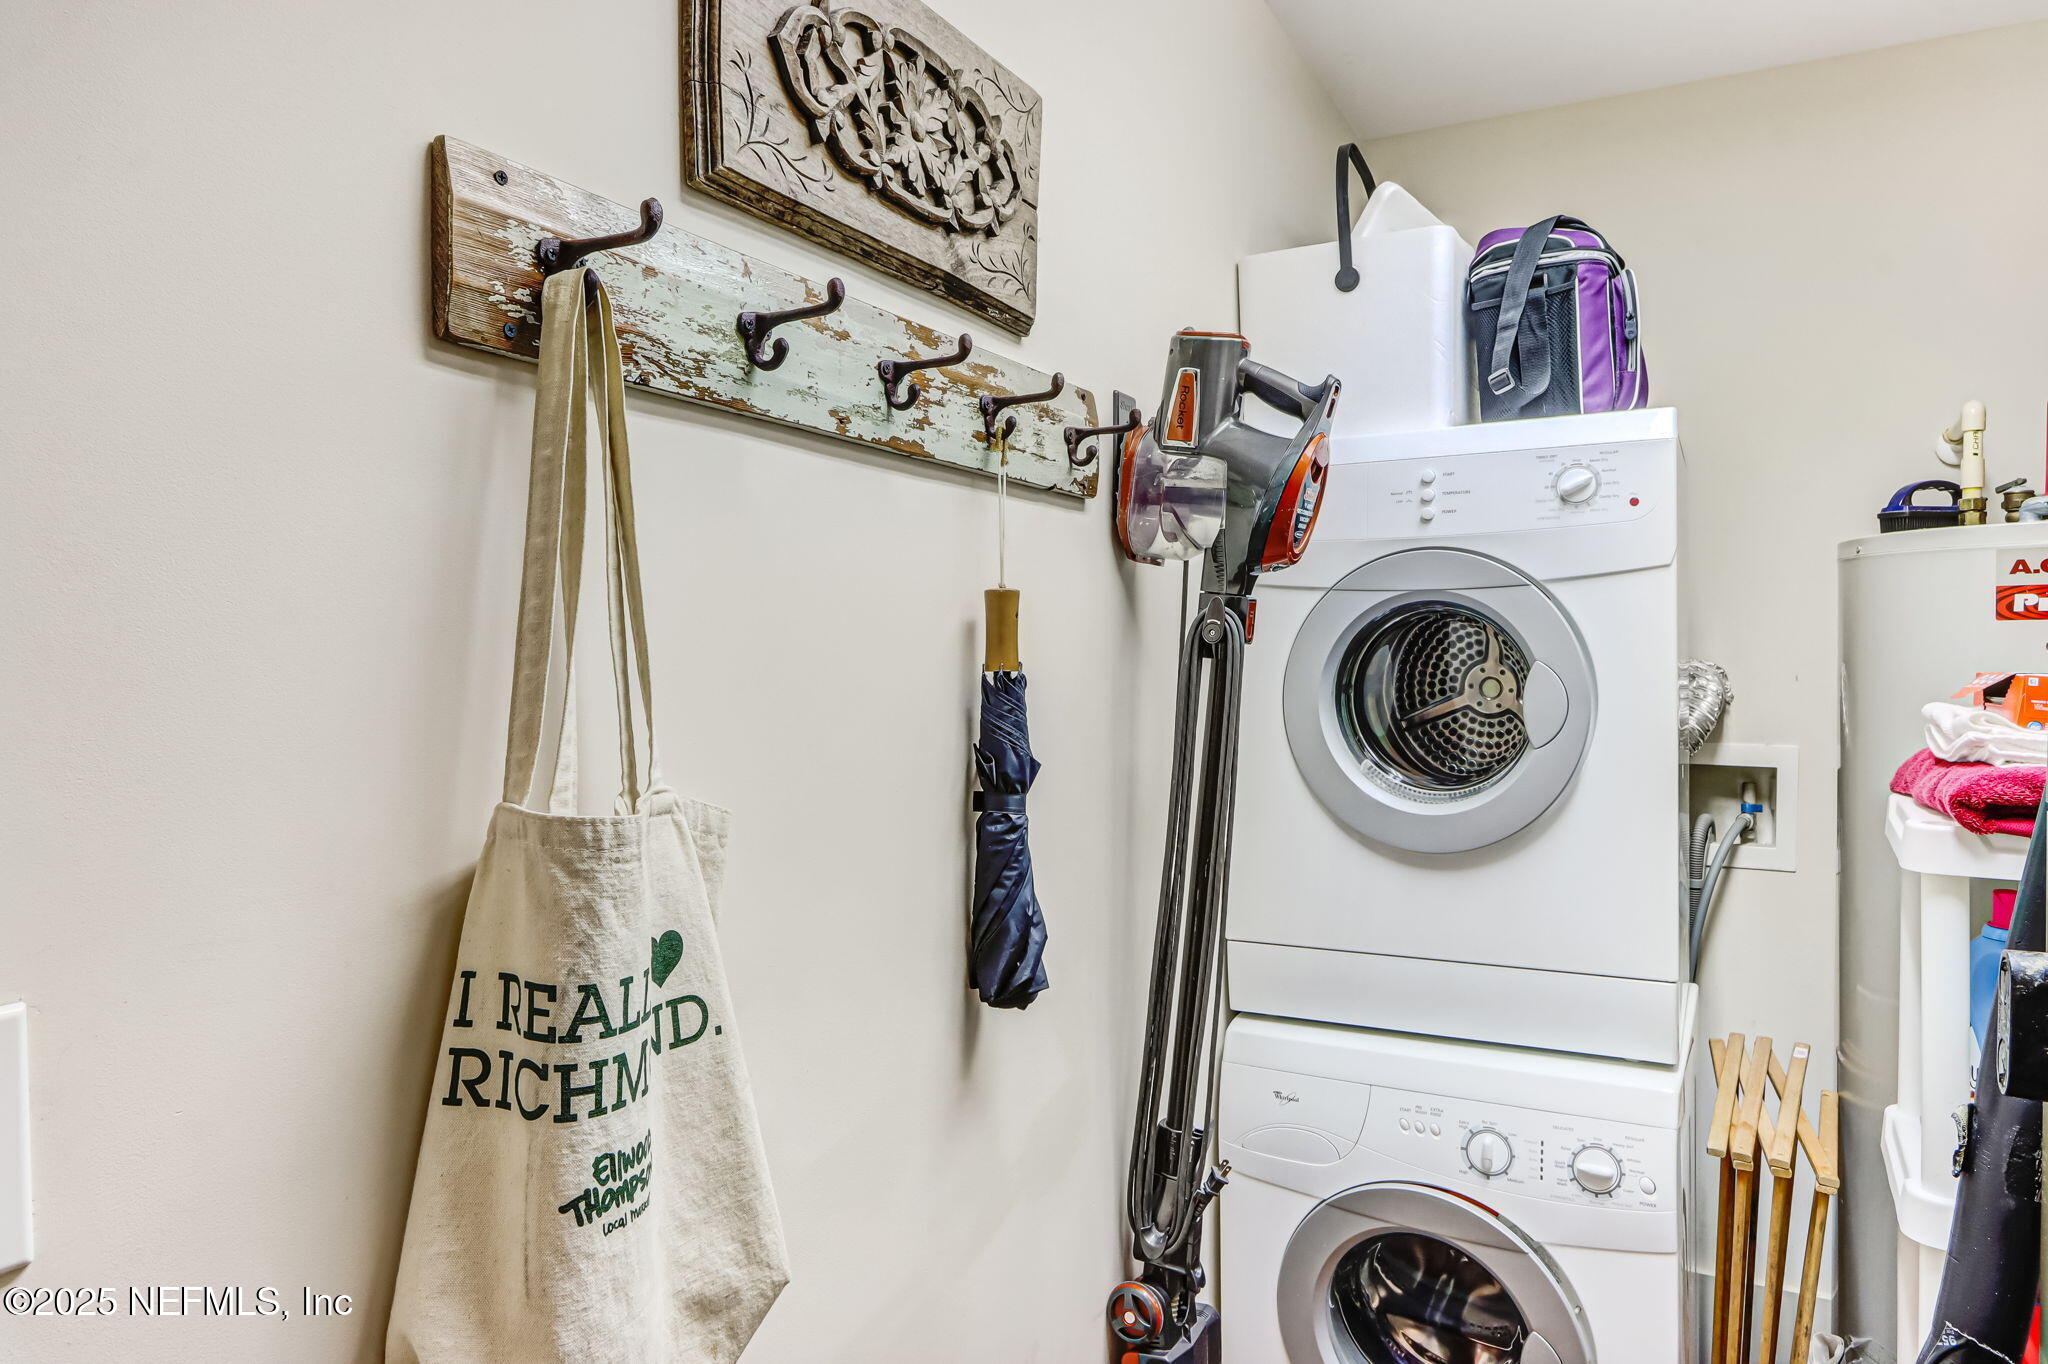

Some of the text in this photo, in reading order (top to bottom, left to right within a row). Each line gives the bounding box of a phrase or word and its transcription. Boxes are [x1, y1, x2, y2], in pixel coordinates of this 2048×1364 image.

[1175, 384, 1191, 430] Rocket
[453, 966, 651, 1045] I REALL
